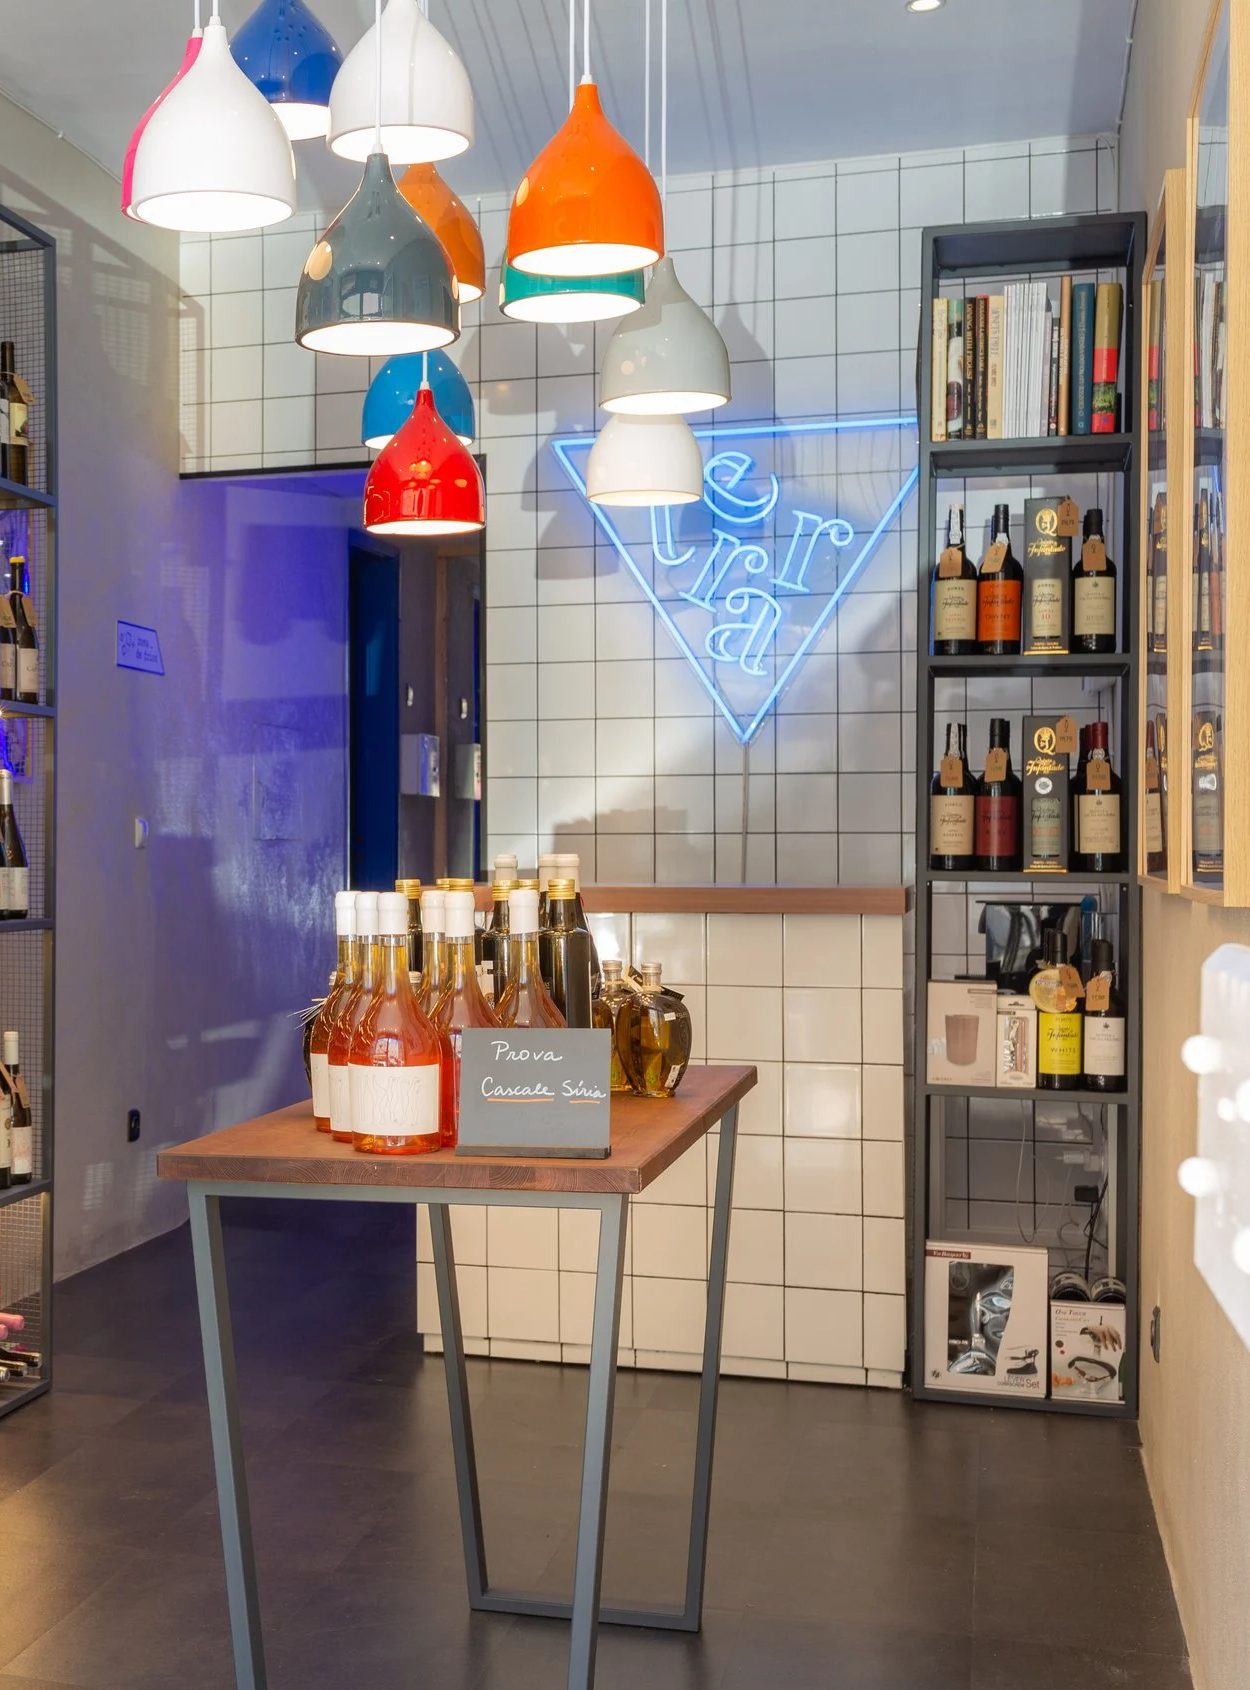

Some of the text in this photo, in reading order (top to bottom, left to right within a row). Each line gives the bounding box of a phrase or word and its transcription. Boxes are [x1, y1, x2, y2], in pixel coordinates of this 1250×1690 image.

[490, 1040, 563, 1061] Prova
[561, 1079, 607, 1098] Síria
[1025, 1377, 1040, 1389] Set
